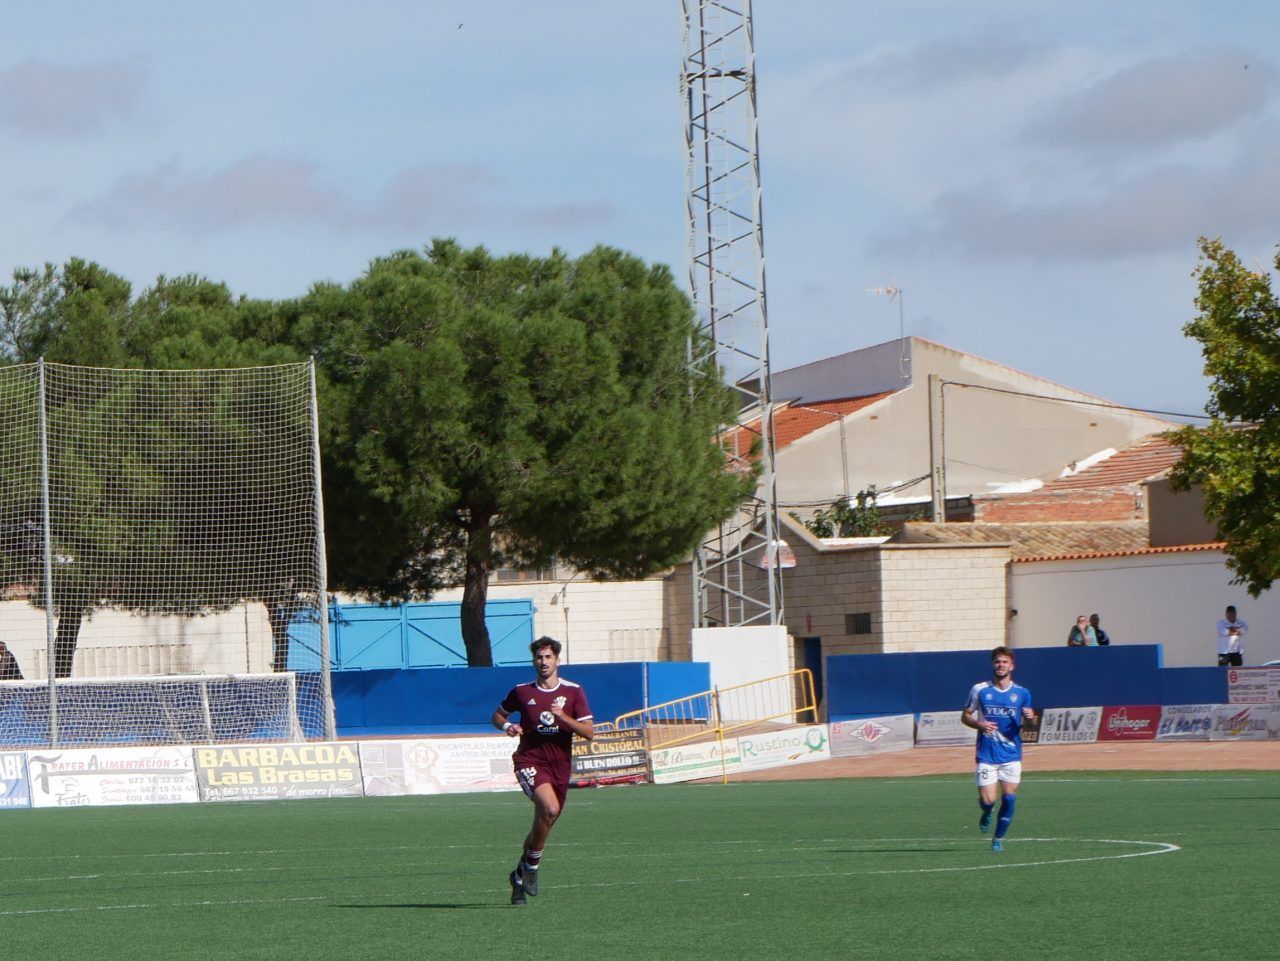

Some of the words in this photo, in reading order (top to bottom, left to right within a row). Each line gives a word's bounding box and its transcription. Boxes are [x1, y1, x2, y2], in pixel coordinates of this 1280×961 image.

[197, 744, 356, 768] BARBACOA
[207, 768, 255, 786] Las
[259, 767, 354, 784] Brasas
